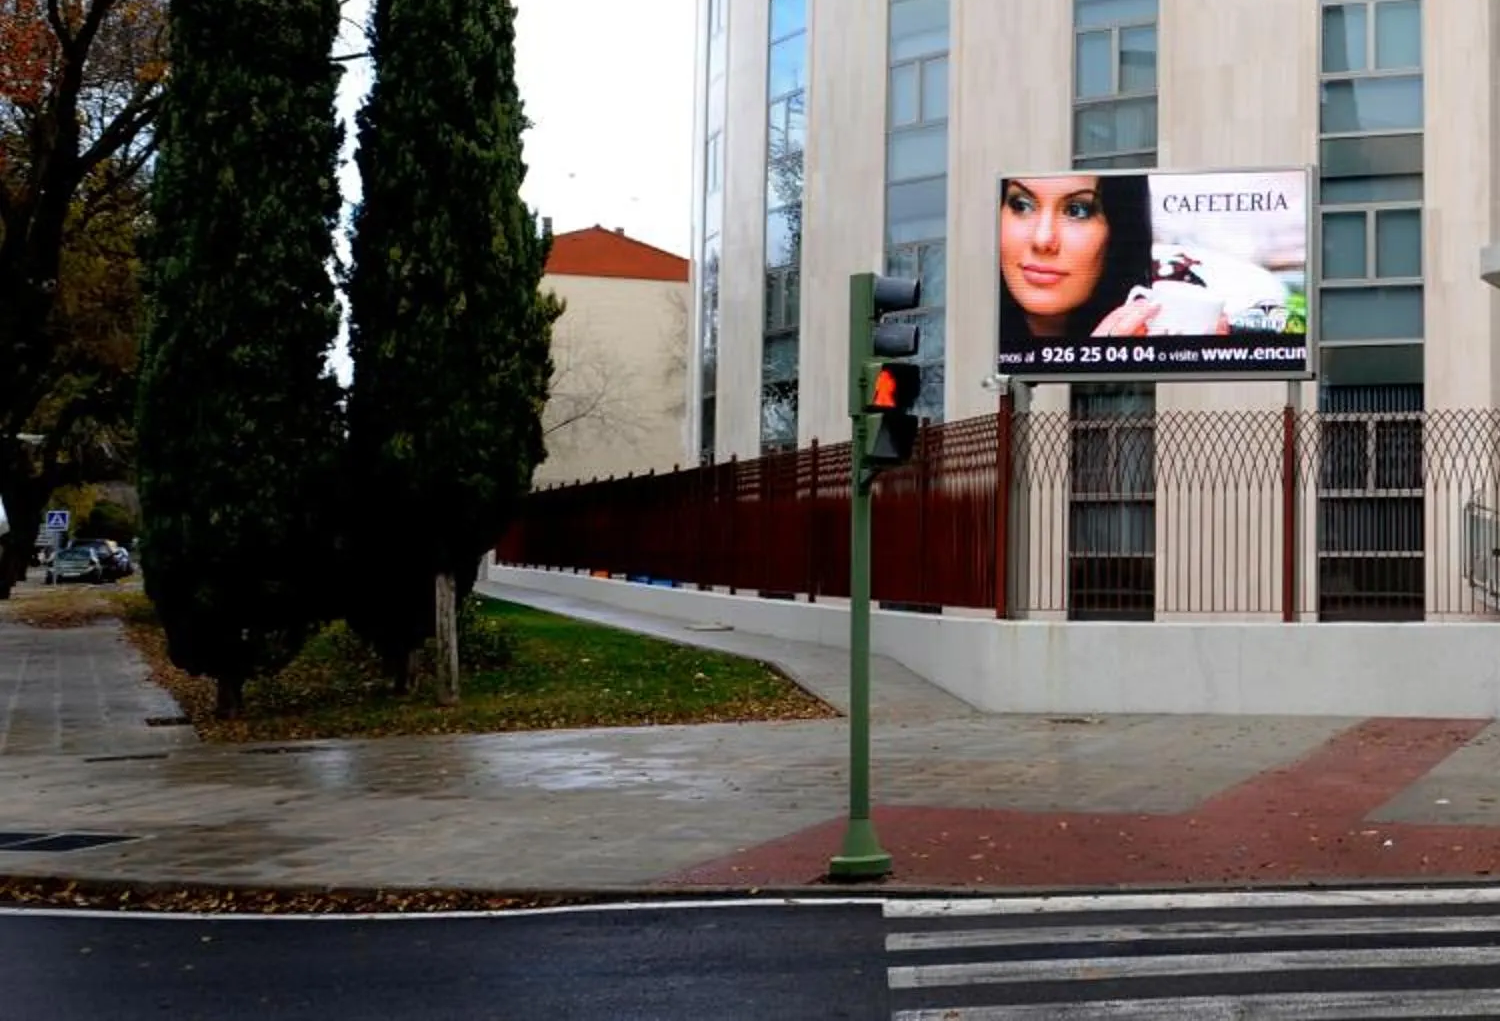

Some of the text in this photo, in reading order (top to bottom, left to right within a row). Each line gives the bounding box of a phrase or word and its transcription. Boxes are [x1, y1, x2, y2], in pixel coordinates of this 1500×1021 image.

[1162, 190, 1289, 214] CAFETERÍA
[1041, 346, 1075, 362] 926
[1079, 346, 1101, 362] 25
[1105, 346, 1128, 362] 04
[1132, 346, 1155, 362] 04
[1169, 350, 1199, 362] visite
